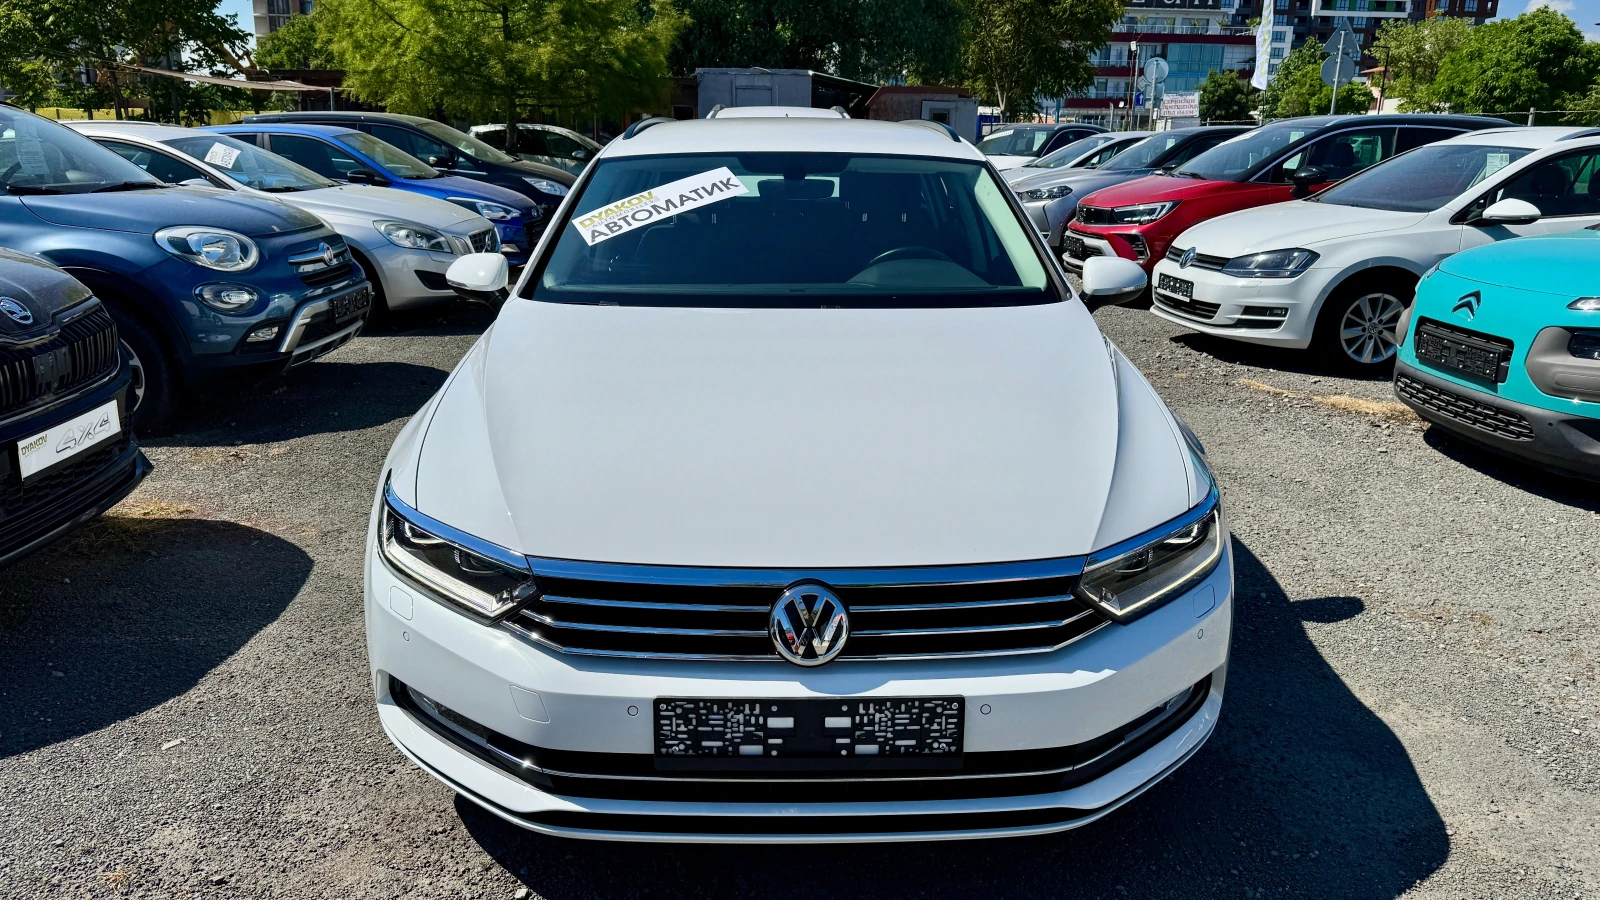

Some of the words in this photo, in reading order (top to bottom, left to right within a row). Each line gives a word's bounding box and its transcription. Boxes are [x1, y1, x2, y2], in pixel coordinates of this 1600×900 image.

[579, 191, 655, 229] DYAKOV
[590, 177, 741, 243] АВТОМАТИК
[592, 200, 654, 228] AUTOMOBILES
[21, 434, 48, 456] DYAKOV
